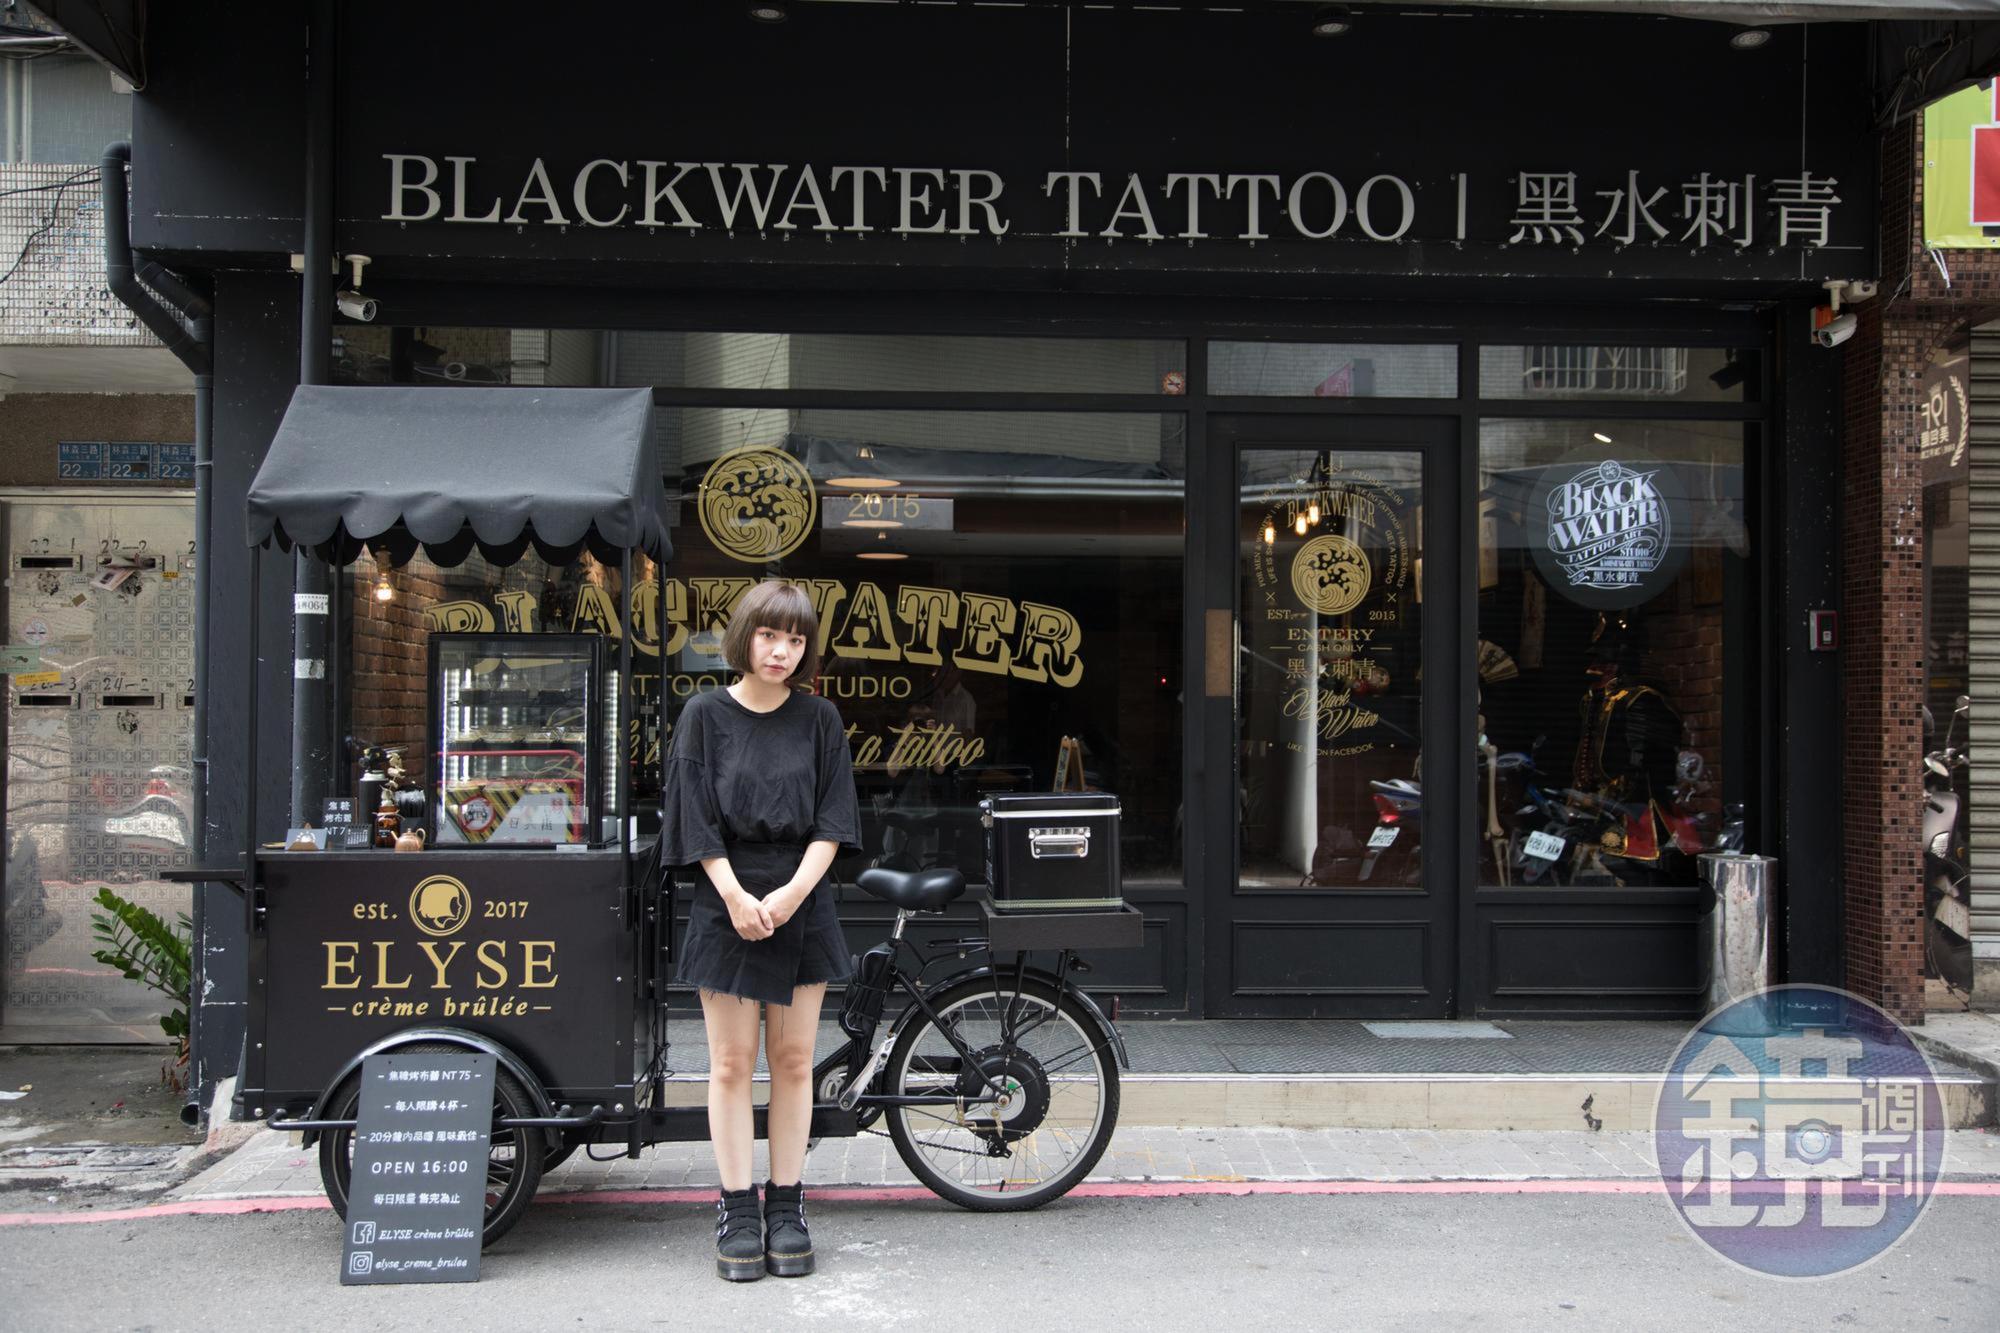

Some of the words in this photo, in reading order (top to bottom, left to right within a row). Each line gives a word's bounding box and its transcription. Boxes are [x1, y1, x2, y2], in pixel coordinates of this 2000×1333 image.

[381, 153, 1009, 236] BLACKWATER
[1046, 171, 1415, 242] TATTOO
[1509, 169, 1842, 248] 黑水刺青
[1547, 470, 1660, 520] BLACK
[848, 493, 920, 519] 2015
[1552, 500, 1660, 550] WATER
[1567, 540, 1616, 563] TATTOO
[1267, 610, 1294, 620] EST.
[1369, 610, 1396, 621] 2015
[1287, 628, 1376, 642] ENTERY
[1333, 644, 1365, 653] ONLY
[887, 722, 985, 768] tattoo
[1330, 742, 1375, 757] FACEBOOK
[353, 901, 399, 920] est.
[484, 901, 530, 919] 2017
[320, 940, 560, 990] ELYSE
[351, 996, 428, 1017] crème
[444, 995, 529, 1018] brûlée
[371, 1161, 416, 1175] OPEN
[421, 1160, 468, 1174] 16:00
[374, 1193, 416, 1205] 每日限量
[418, 1192, 461, 1204] 售完為止
[377, 1229, 413, 1241] ELYSE
